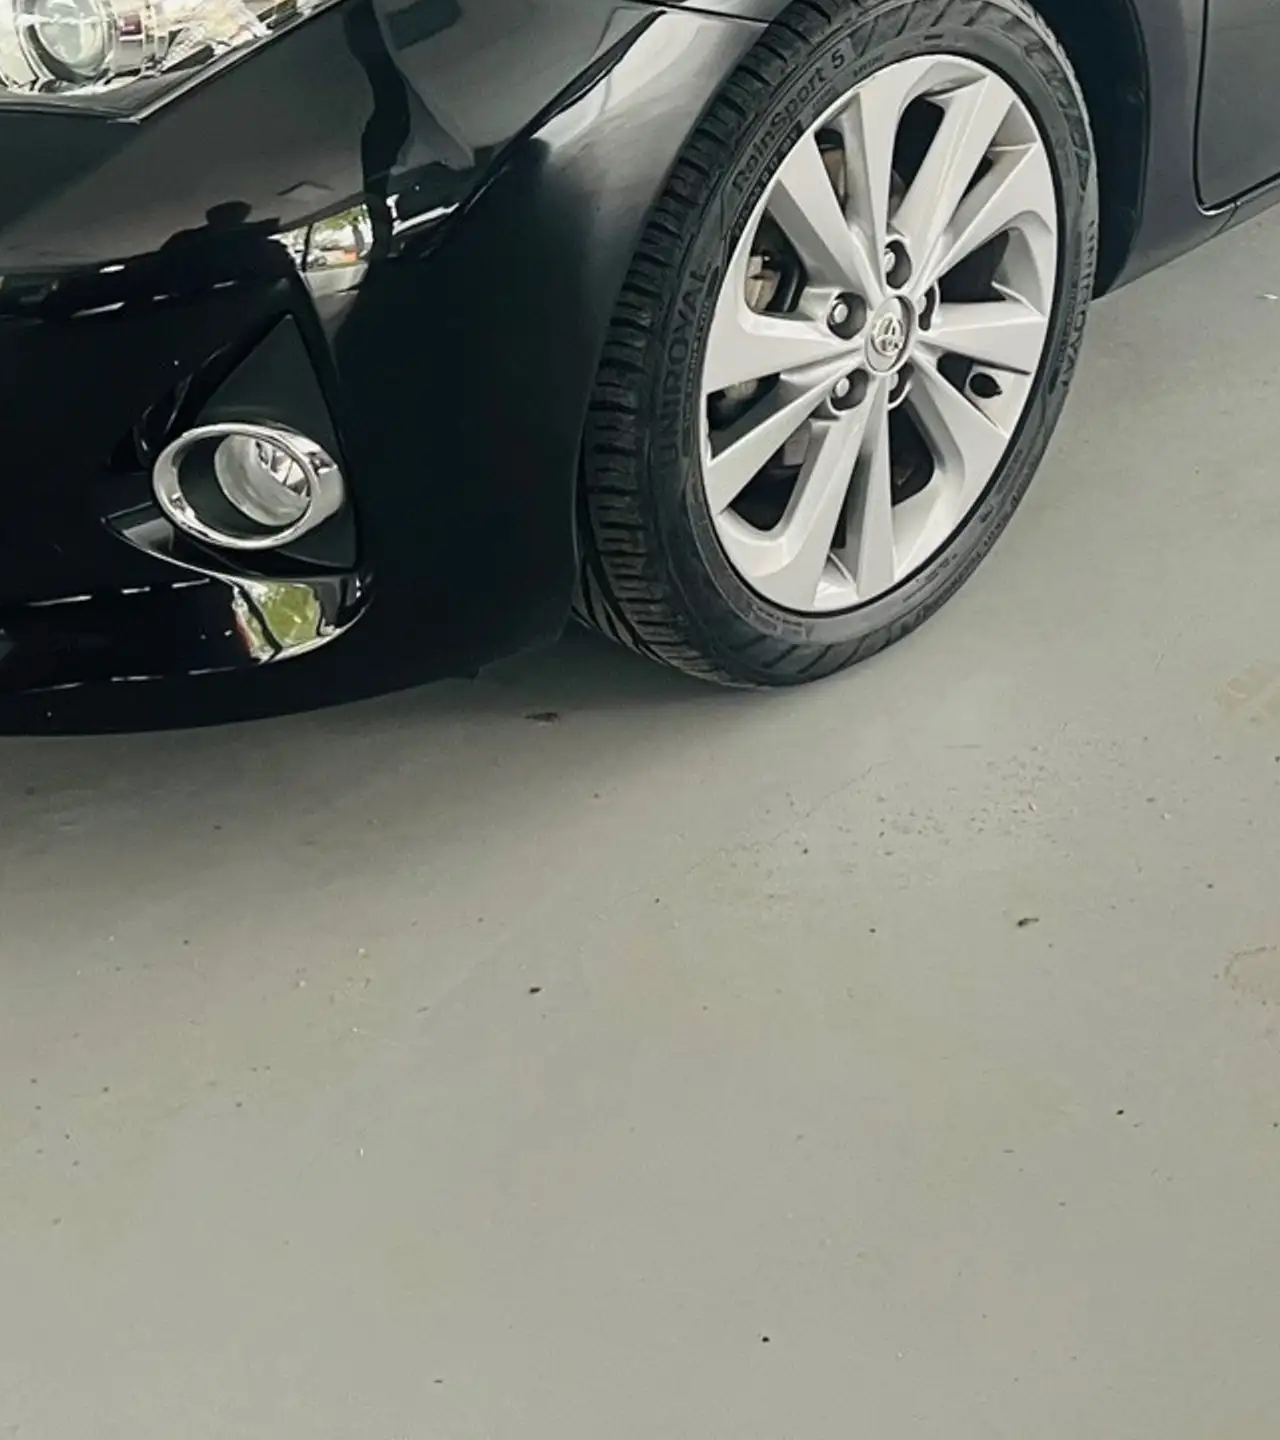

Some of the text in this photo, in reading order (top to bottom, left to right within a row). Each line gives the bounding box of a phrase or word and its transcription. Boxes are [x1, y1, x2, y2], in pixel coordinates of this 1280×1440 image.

[731, 68, 830, 193] RainSport
[830, 47, 846, 71] 5
[660, 262, 713, 460] UNIROYAL
